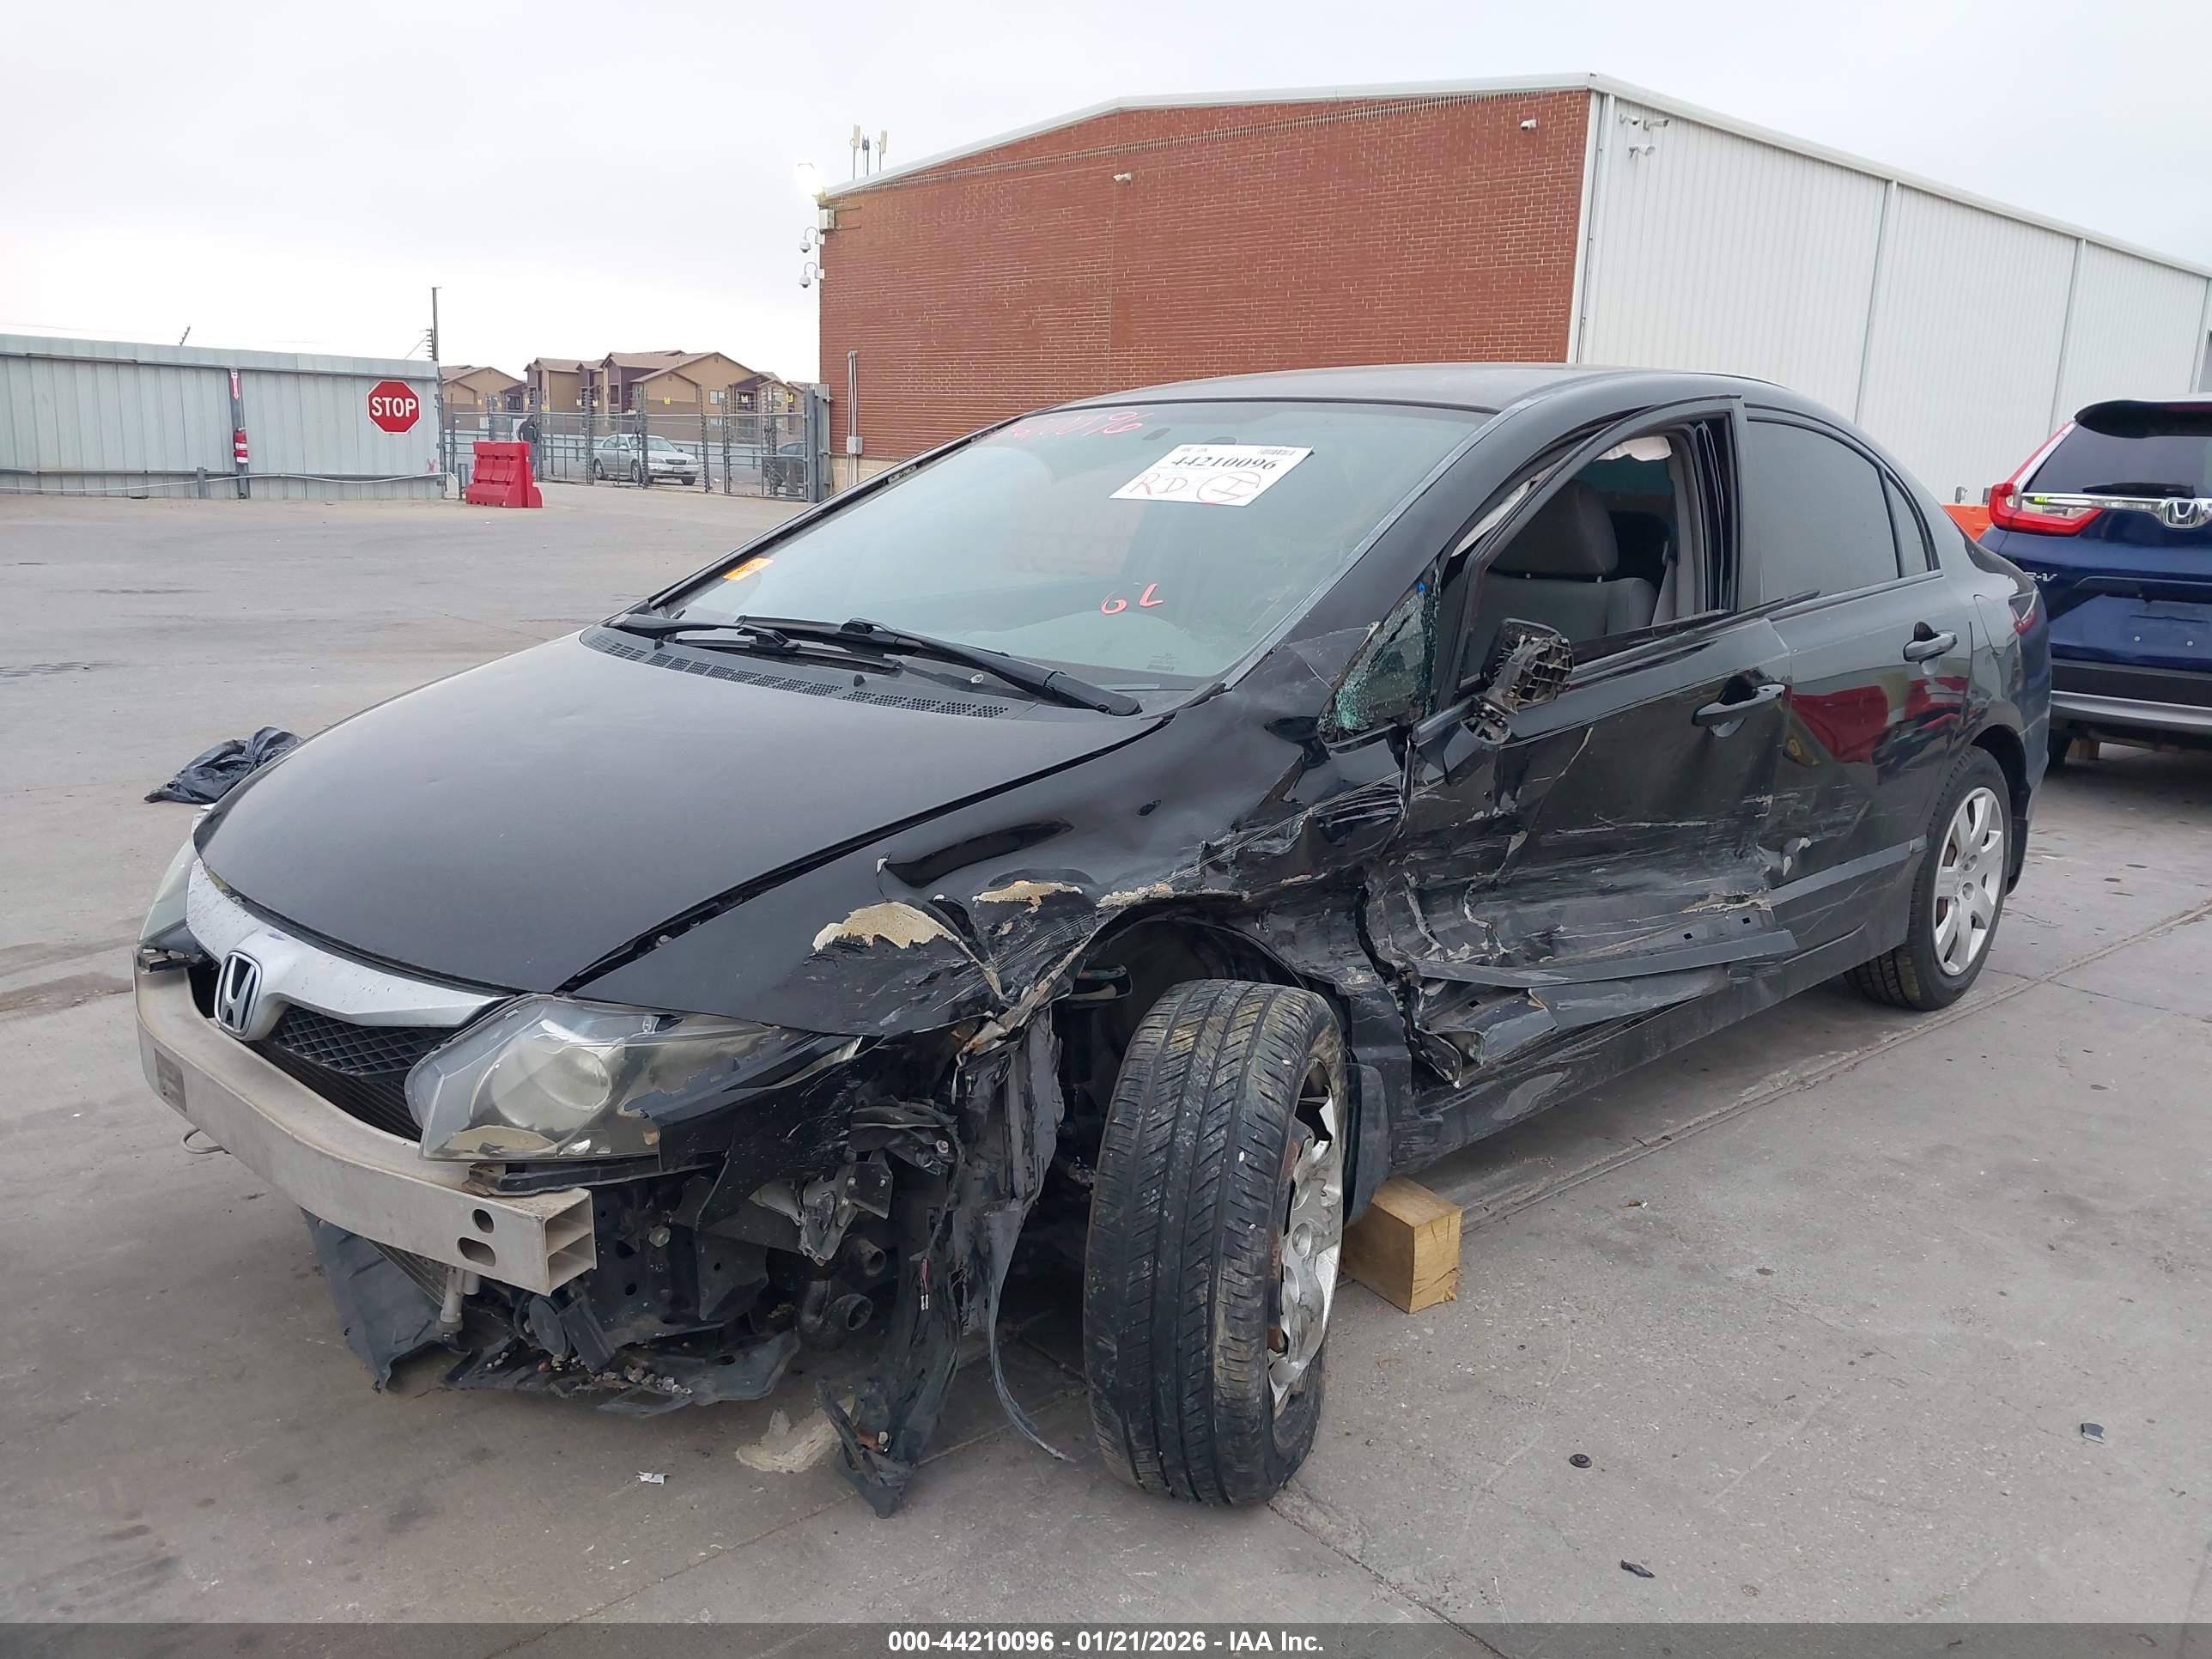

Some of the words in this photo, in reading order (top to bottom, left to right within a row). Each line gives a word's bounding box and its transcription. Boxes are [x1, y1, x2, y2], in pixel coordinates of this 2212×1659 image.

[371, 396, 417, 417] STOP
[1171, 455, 1279, 471] 44210096
[2023, 571, 2058, 582] R-V
